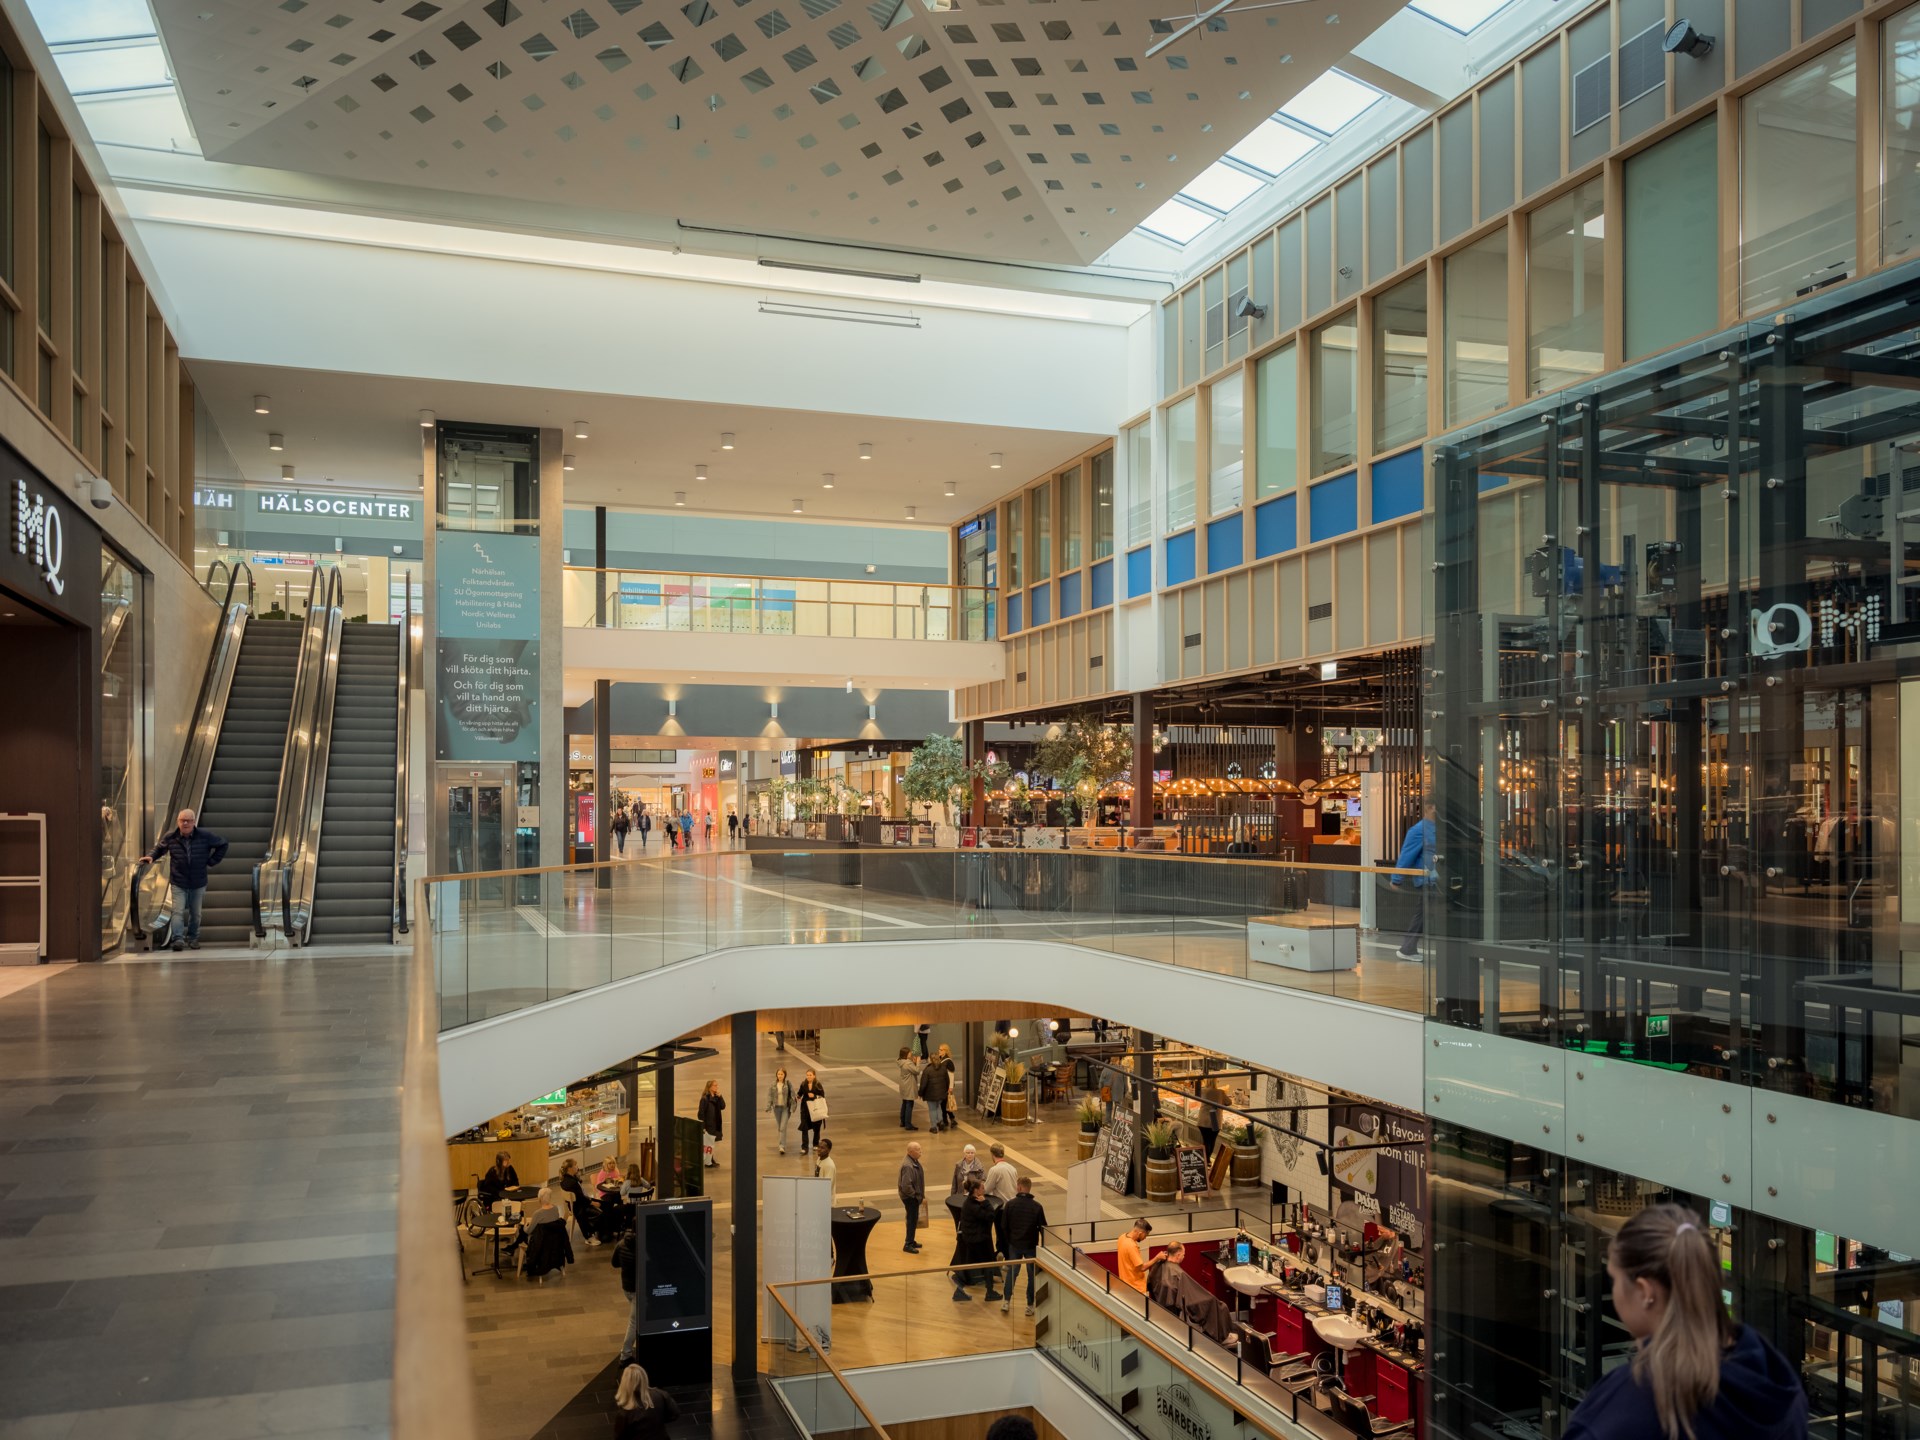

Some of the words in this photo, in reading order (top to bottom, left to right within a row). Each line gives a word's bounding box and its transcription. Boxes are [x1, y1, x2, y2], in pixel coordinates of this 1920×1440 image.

[261, 493, 410, 518] HÄLSOCENTER
[17, 480, 64, 595] MQ
[471, 567, 506, 576] Närhälsan
[462, 577, 515, 587] Folktandvården
[465, 587, 523, 599] Ögonmottagning
[455, 599, 496, 609] Habilitering
[461, 610, 485, 618] Nordic
[486, 611, 516, 619] Wellness
[476, 621, 502, 629] Unilabs
[463, 653, 477, 663] För
[479, 654, 494, 665] dig
[445, 665, 459, 673] vill
[460, 665, 484, 674] sköta
[485, 666, 502, 675] ditt
[503, 666, 532, 677] hjärta.
[453, 680, 473, 690] Och
[474, 681, 488, 690] för
[489, 682, 504, 692] dig
[456, 692, 470, 700] vill
[482, 693, 505, 701] hand
[465, 704, 482, 712] ditt
[483, 704, 512, 715] hjärta.
[1354, 1190, 1381, 1215] PASTA
[1389, 1204, 1416, 1223] BASTARD
[1389, 1215, 1416, 1233] BURGERS
[1067, 1331, 1088, 1362] DROP
[1091, 1351, 1100, 1373] IN
[1162, 1398, 1204, 1440] BARBERS
